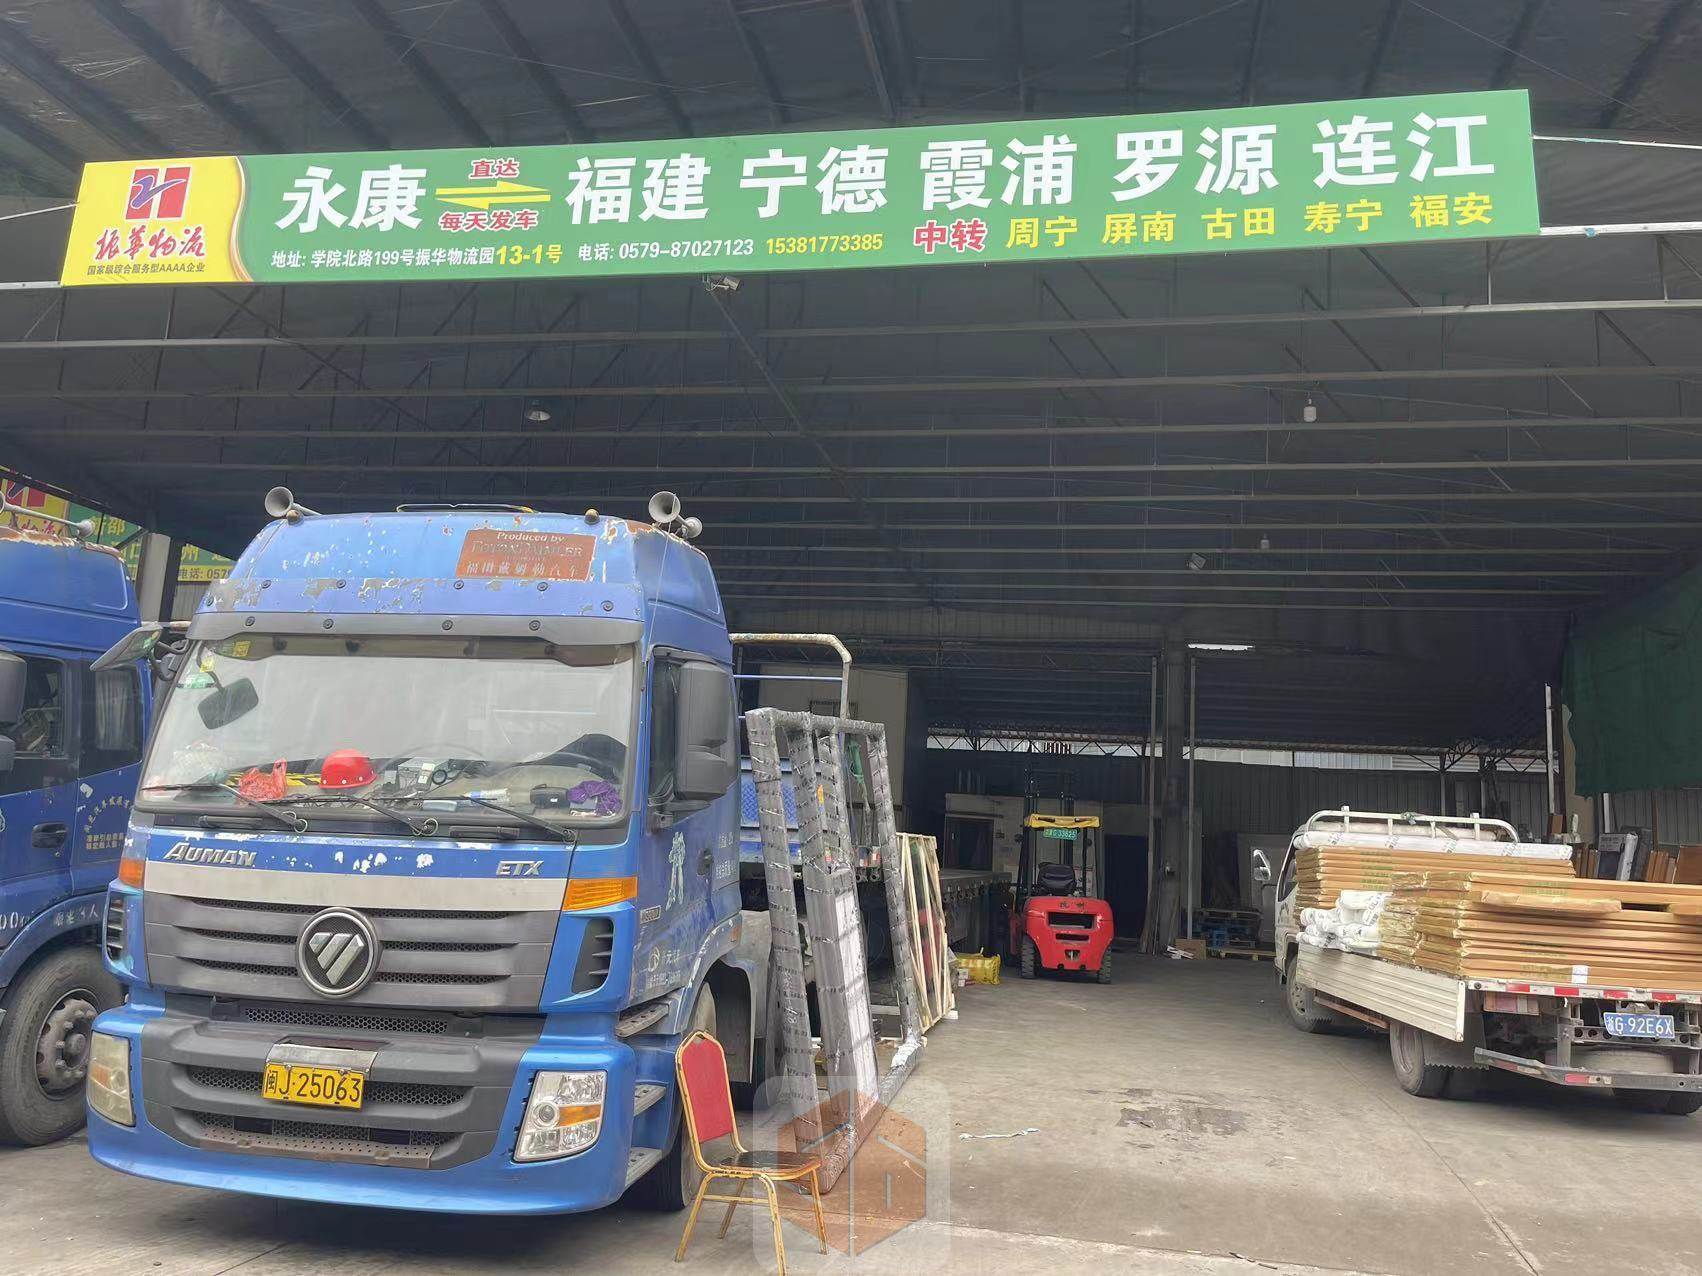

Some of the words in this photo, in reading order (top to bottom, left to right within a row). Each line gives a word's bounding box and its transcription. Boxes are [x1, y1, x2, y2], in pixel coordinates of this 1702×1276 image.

[275, 164, 427, 233] 永康
[565, 152, 712, 225] 福建
[739, 144, 889, 218] 宁德
[920, 134, 1078, 211] 霞浦
[1109, 124, 1280, 201] 罗源
[1312, 112, 1495, 189] 连江
[470, 159, 520, 180] 直达
[439, 210, 539, 233] 每天发车
[914, 218, 989, 254] 中转
[1006, 215, 1078, 248] 周宁
[1102, 210, 1177, 244] 屏南
[1201, 207, 1276, 240] 古田
[1304, 199, 1383, 234] 寿宁
[1409, 192, 1494, 228] 福安
[618, 239, 754, 260] 0579-87027123
[766, 234, 884, 255] 15381773385
[87, 262, 206, 275] 国家级综合服务型AAAA企业
[496, 860, 544, 876] ETX
